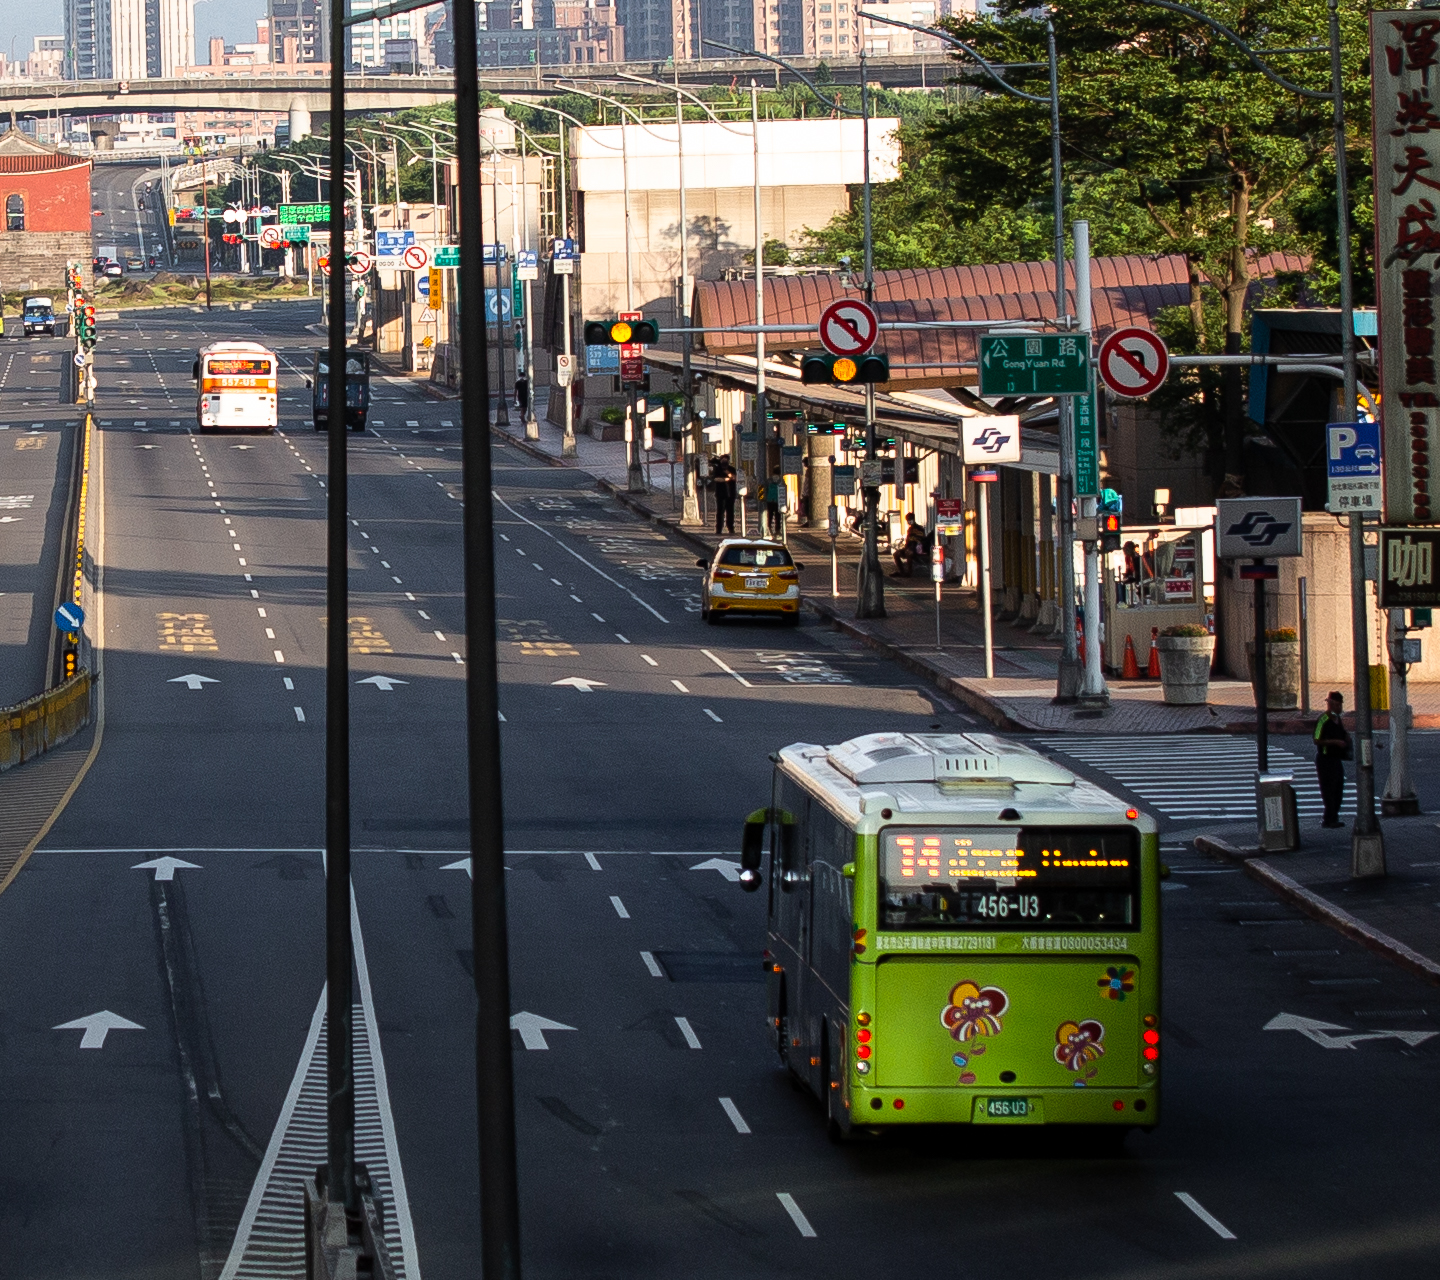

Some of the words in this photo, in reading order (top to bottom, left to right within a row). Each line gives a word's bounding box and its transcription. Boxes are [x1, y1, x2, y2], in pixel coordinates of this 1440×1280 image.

[991, 337, 1077, 357] 公園路
[1051, 359, 1065, 368] Rd.
[1328, 427, 1357, 461] P
[1338, 495, 1373, 508] 停車場
[977, 894, 1041, 918] 456-U3
[987, 1099, 1028, 1116] 456-U3
